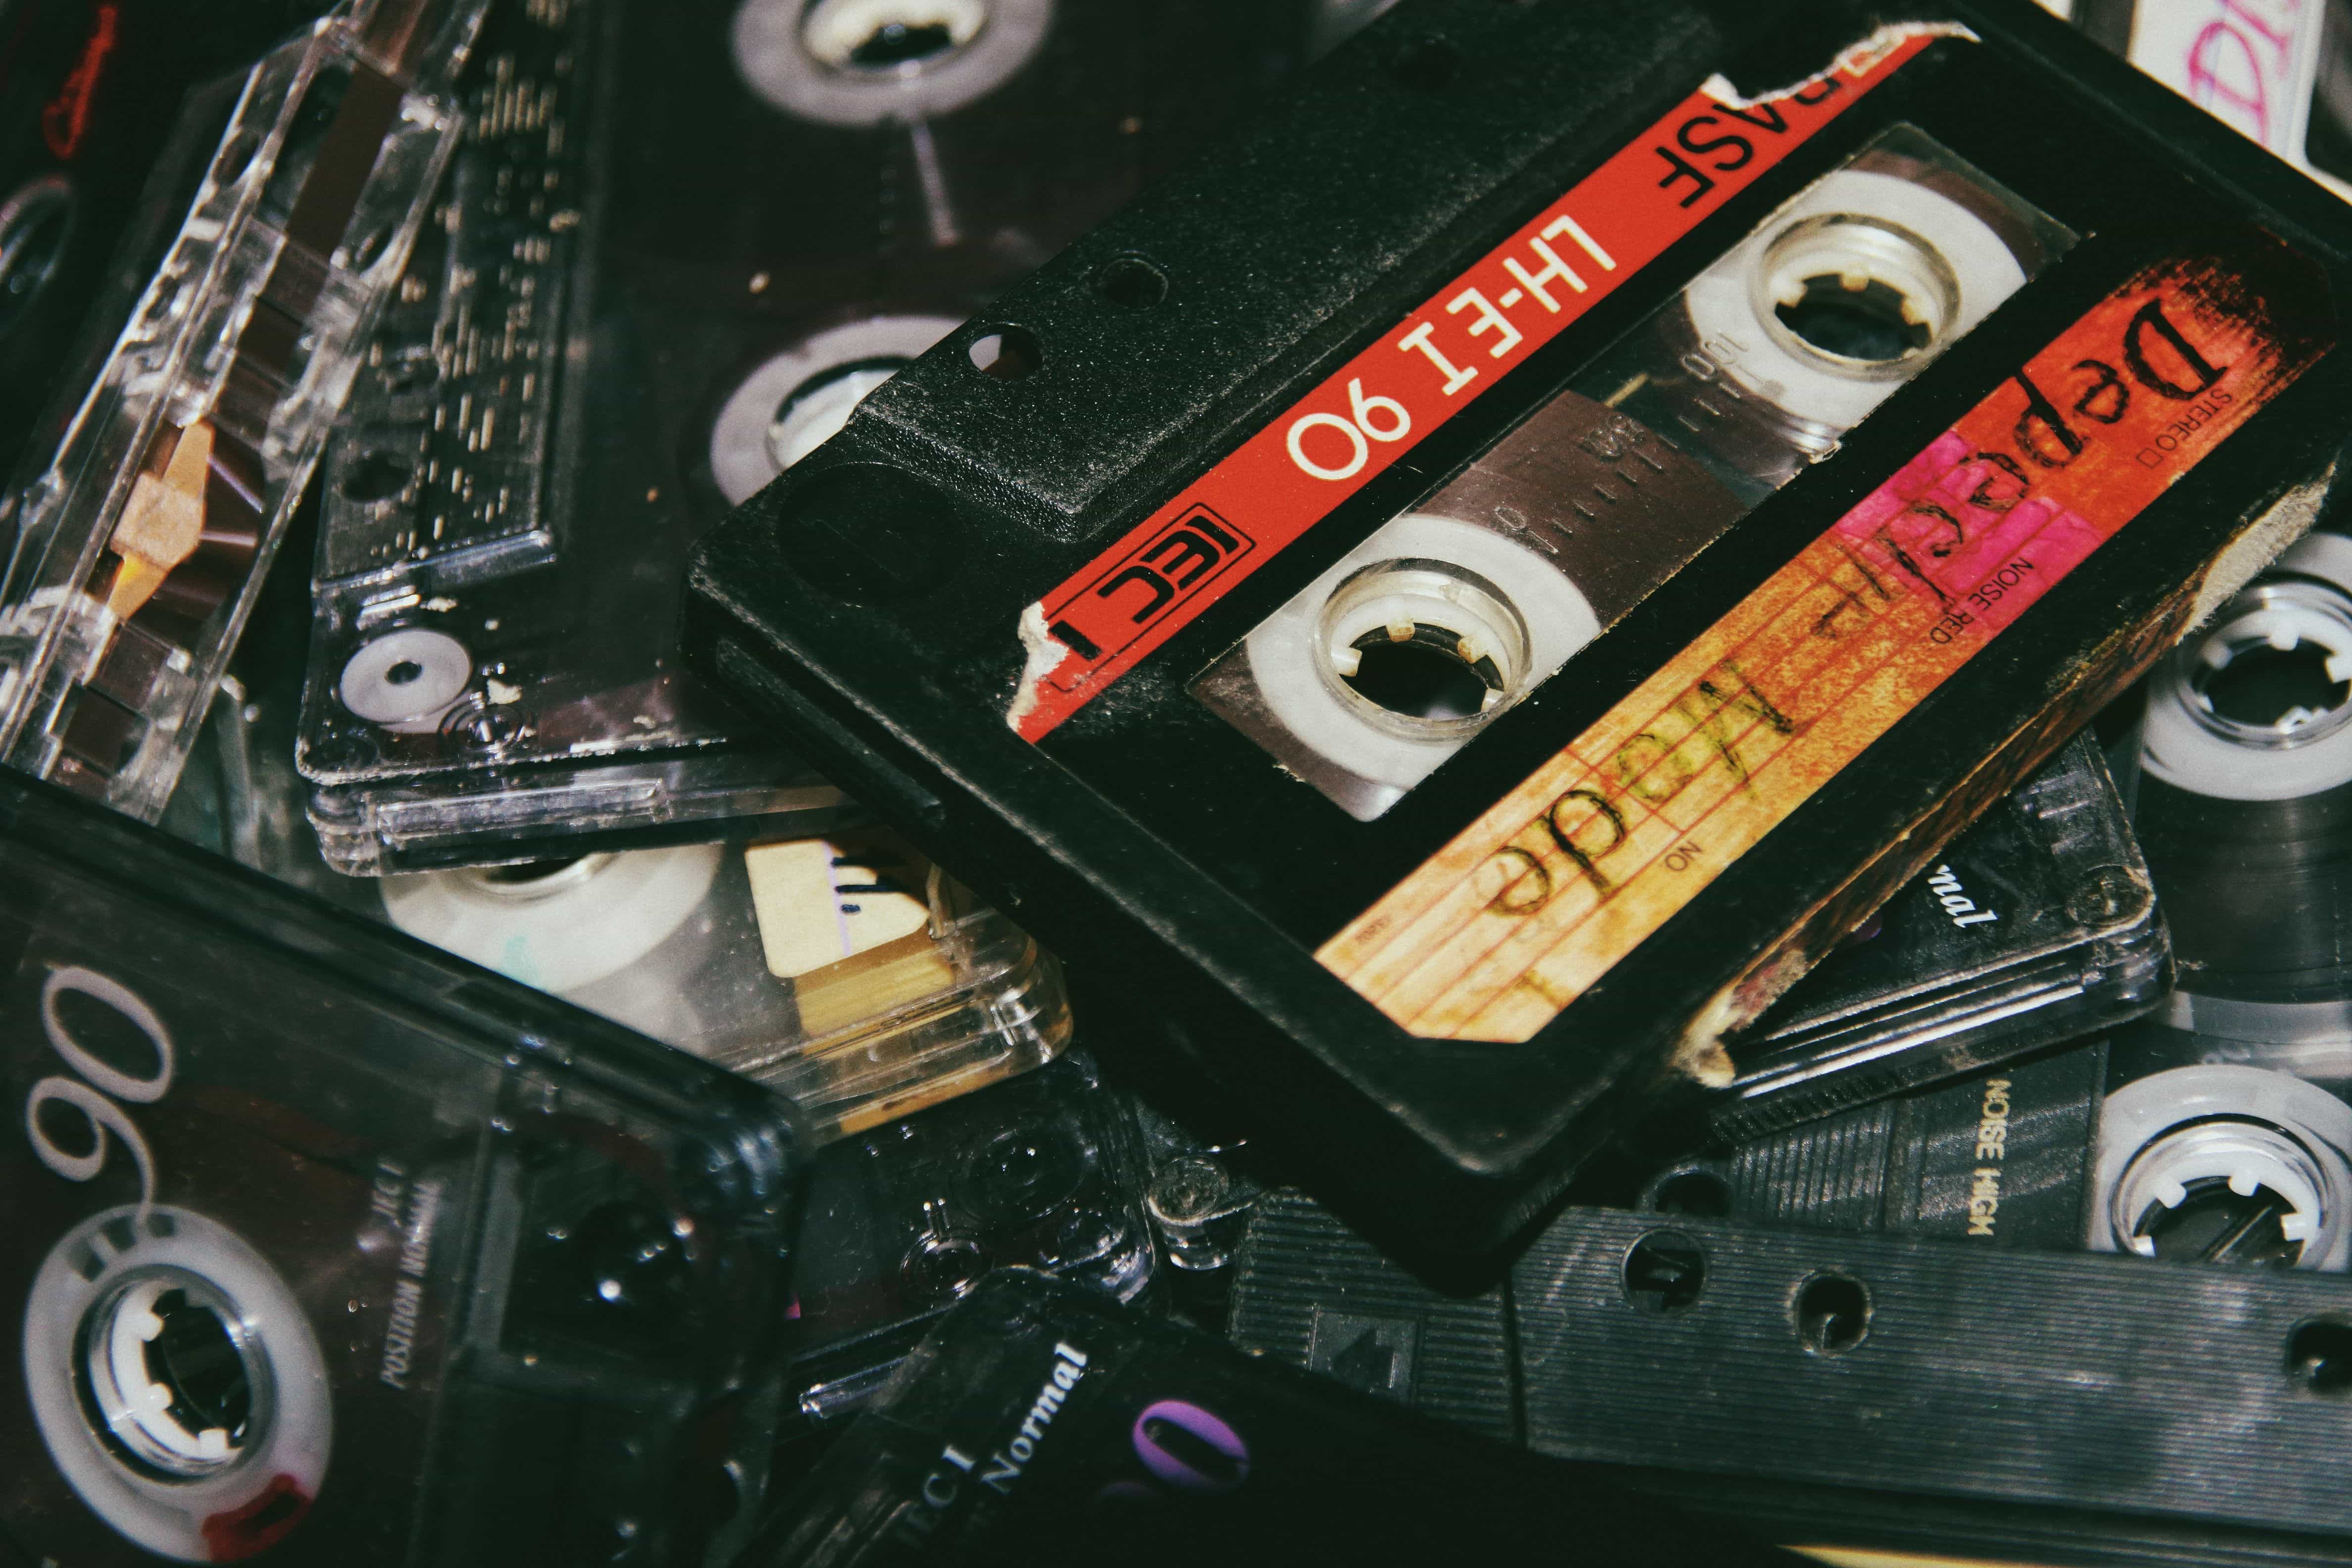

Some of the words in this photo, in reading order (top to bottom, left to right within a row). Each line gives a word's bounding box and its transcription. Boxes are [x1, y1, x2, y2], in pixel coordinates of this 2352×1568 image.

[1286, 377, 1411, 481] 90
[2156, 388, 2232, 454] STEREO
[1097, 515, 1239, 624] IEC
[1968, 556, 2035, 610] NOISE
[1929, 606, 1979, 645] RED
[1484, 658, 1801, 916] Mode
[1665, 840, 1702, 873] NO
[1927, 864, 1999, 929] mal
[26, 964, 176, 1237] 90
[1975, 1078, 2013, 1161] NOISE
[380, 1280, 423, 1390] POSITION
[980, 1340, 1089, 1496] Normal
